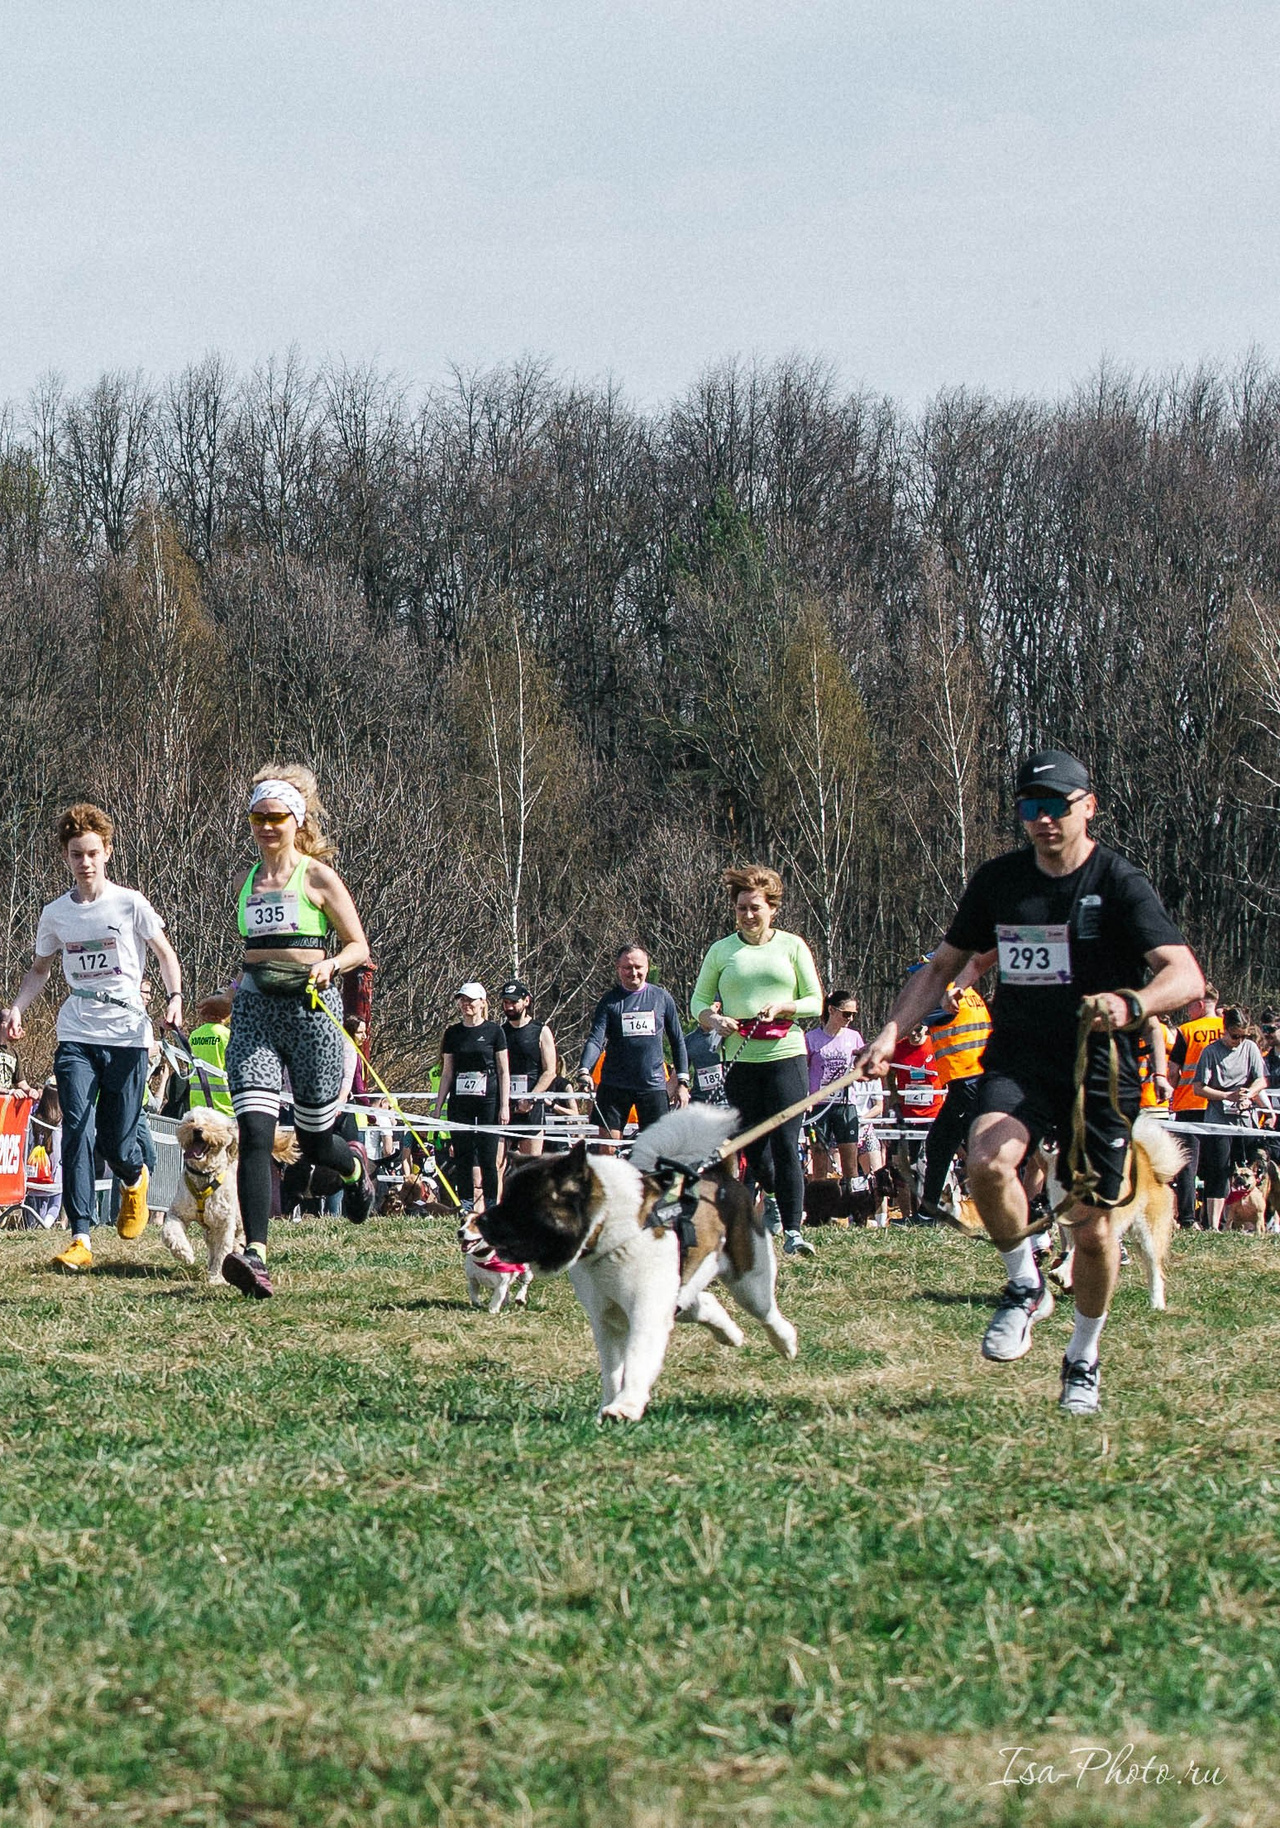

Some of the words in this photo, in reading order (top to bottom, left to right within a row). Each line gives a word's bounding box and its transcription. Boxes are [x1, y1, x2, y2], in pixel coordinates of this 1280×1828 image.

[254, 906, 285, 925] 335
[79, 953, 108, 971] 172
[1008, 947, 1051, 970] 293
[629, 1021, 648, 1030] 164
[464, 1080, 476, 1090] 47
[703, 1073, 721, 1085] 189
